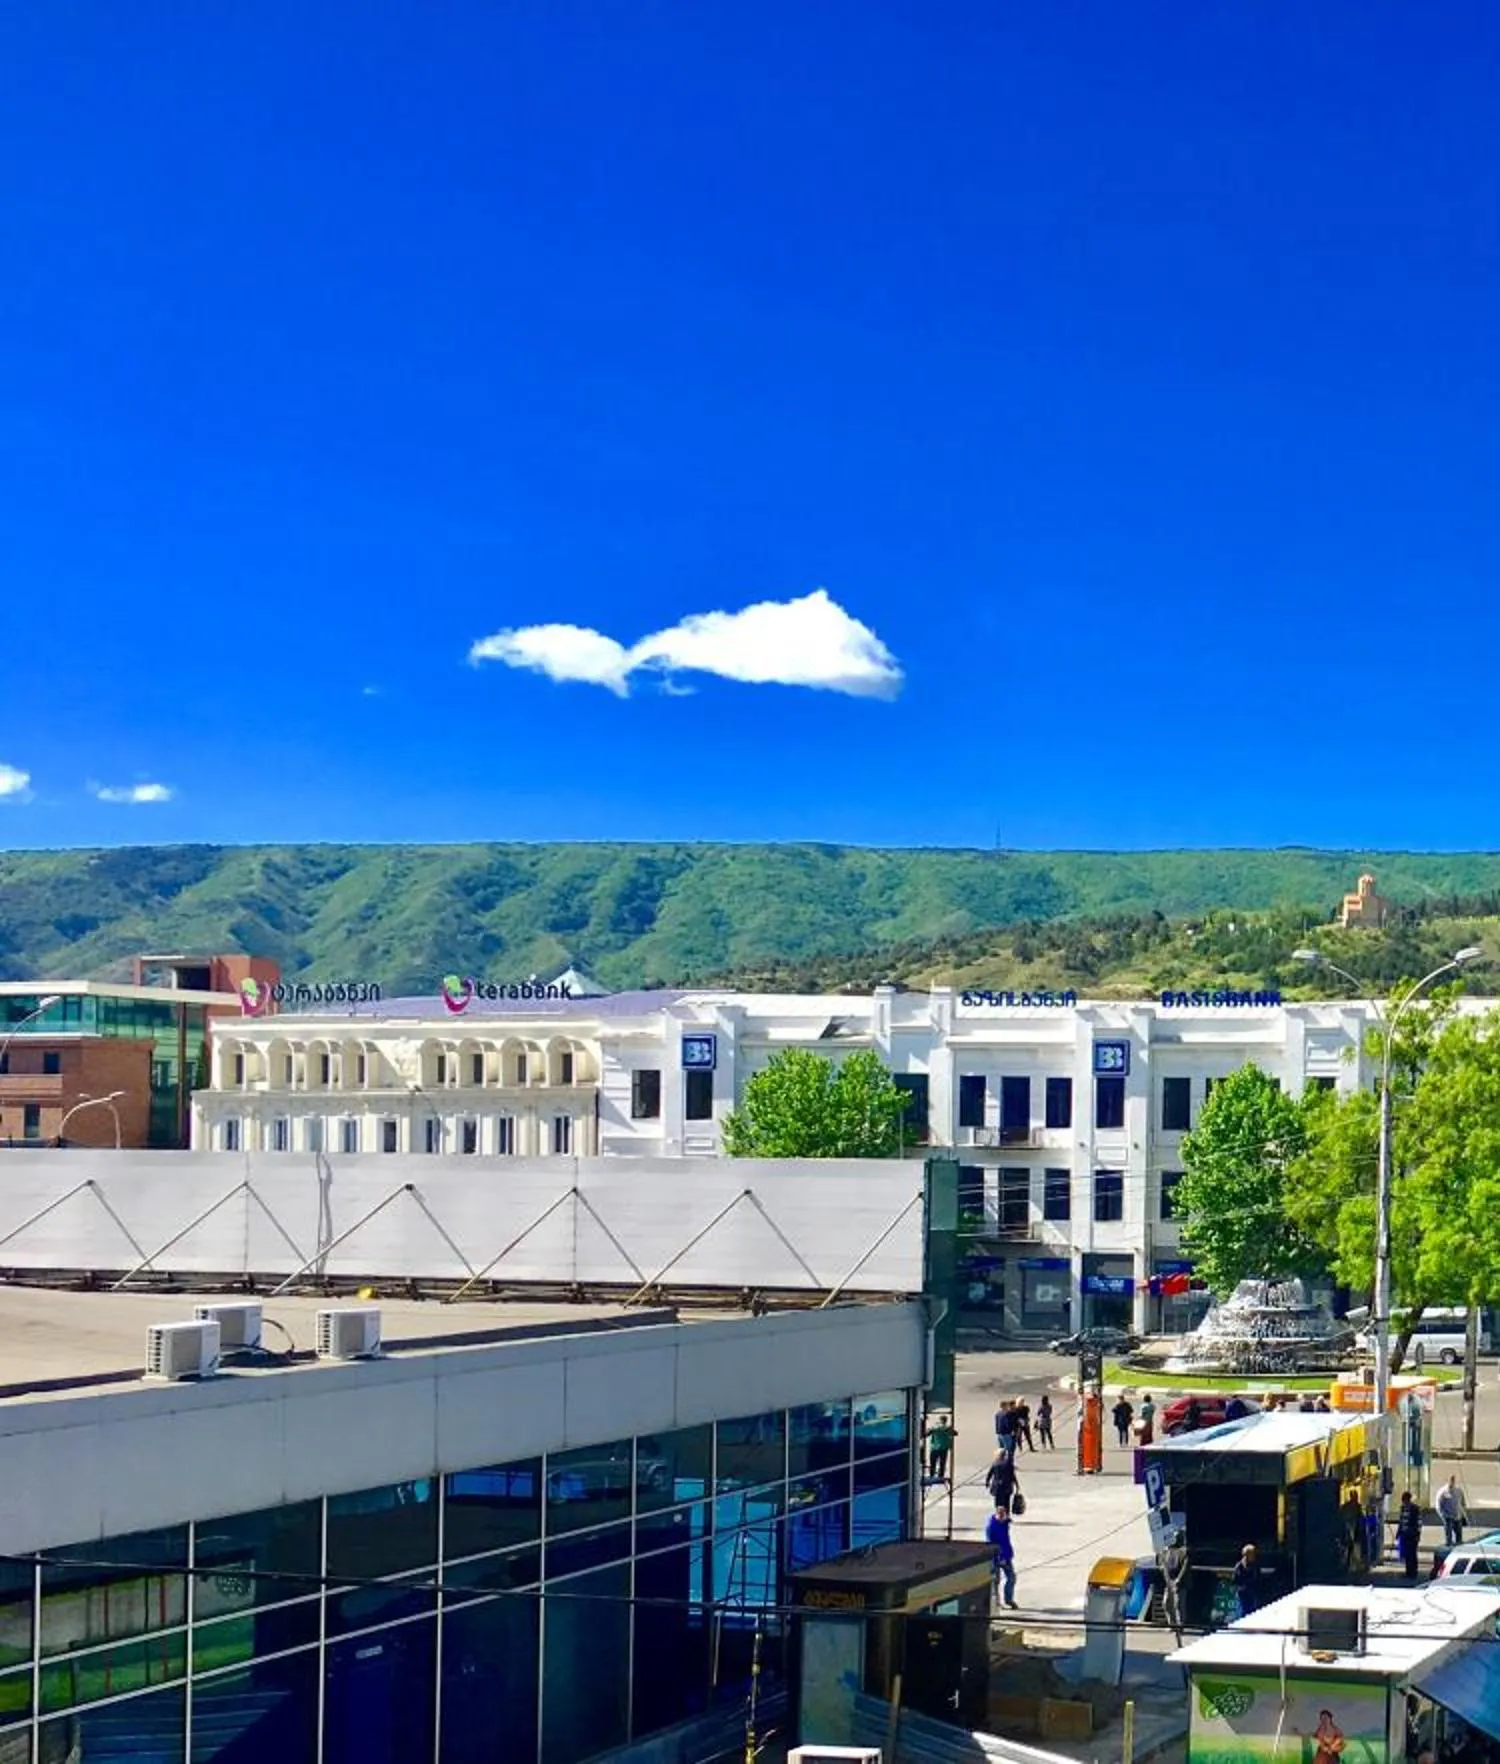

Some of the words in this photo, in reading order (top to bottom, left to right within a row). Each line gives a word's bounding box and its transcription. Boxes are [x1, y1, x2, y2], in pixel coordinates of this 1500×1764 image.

[477, 981, 571, 999] terabank
[1161, 991, 1281, 1008] BASISBANK
[1147, 1470, 1161, 1505] P
